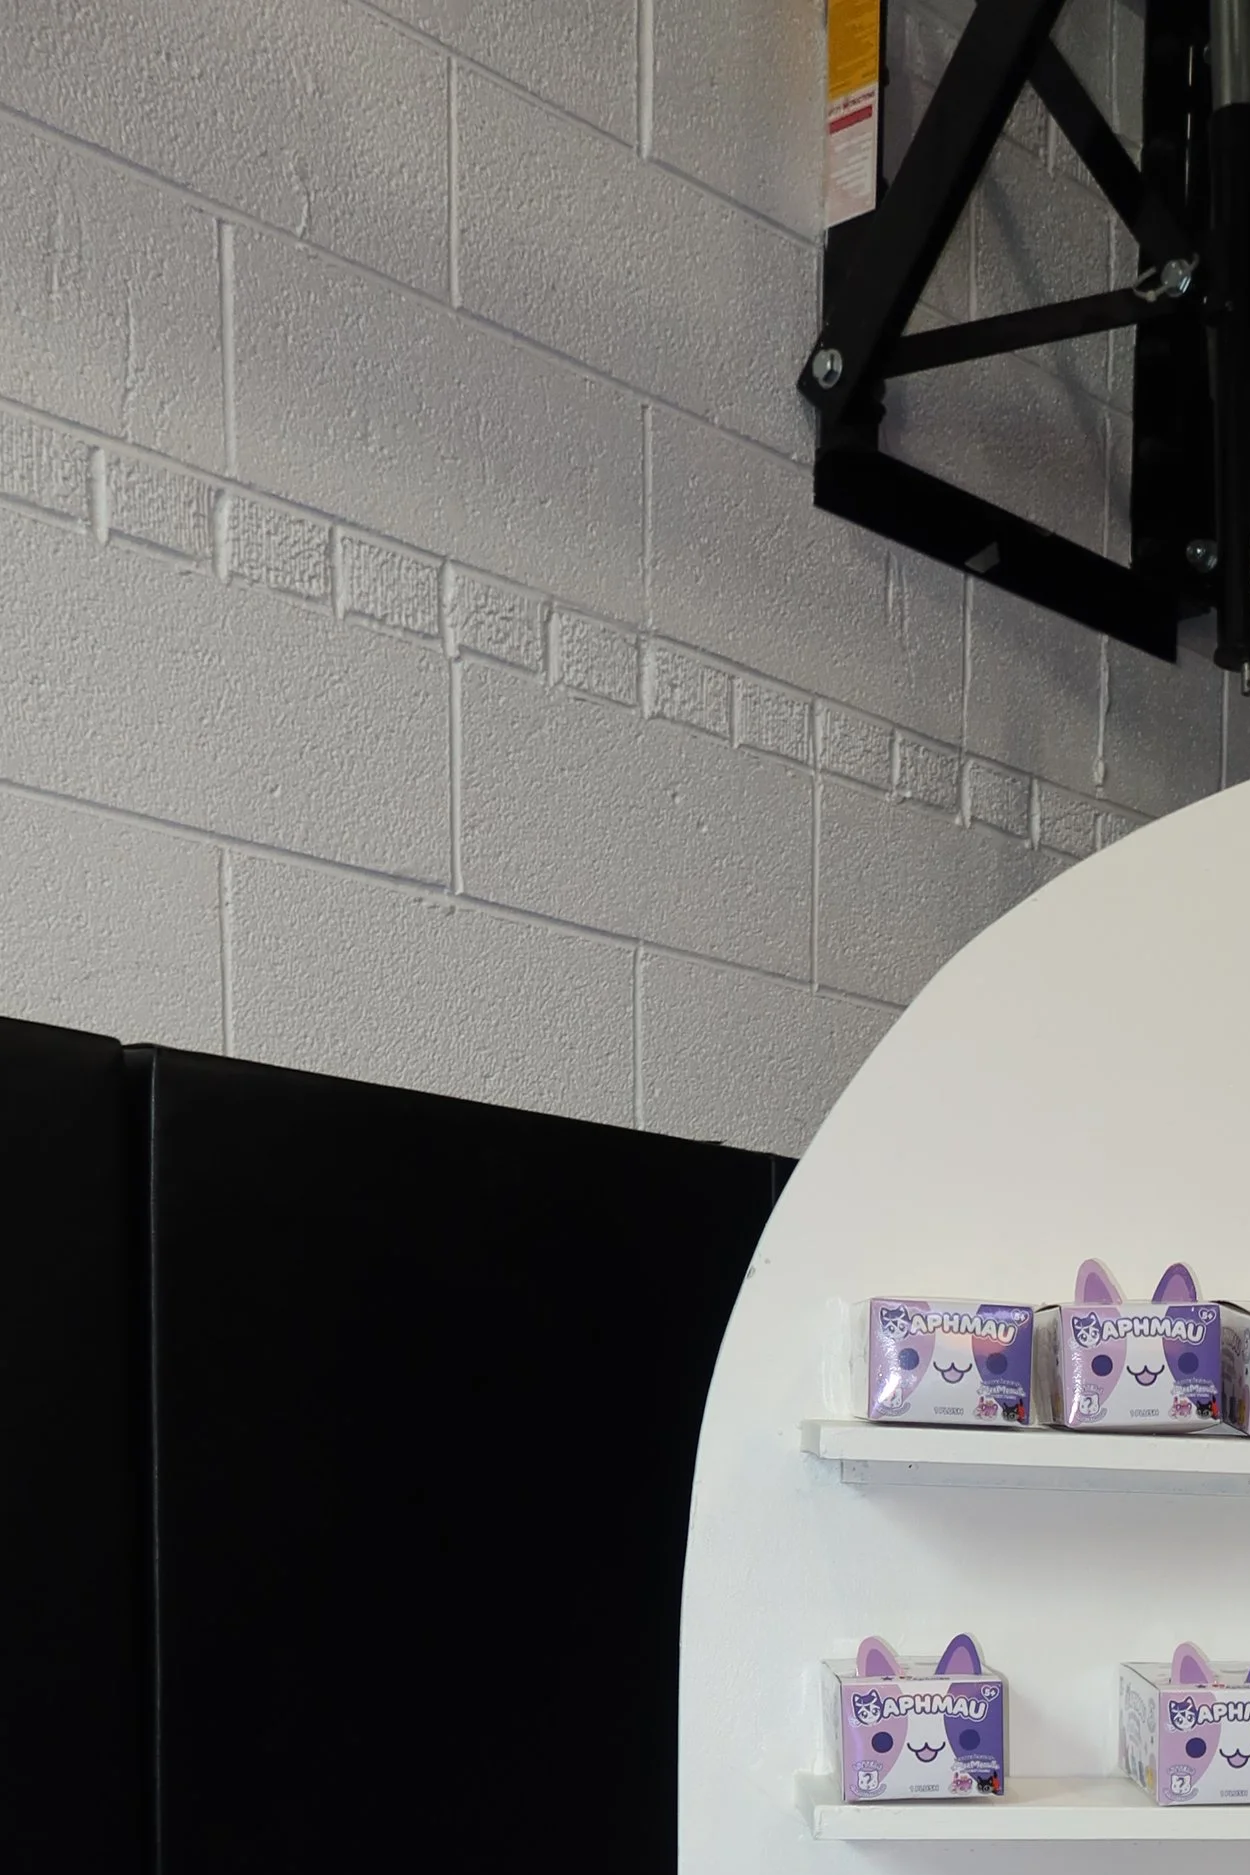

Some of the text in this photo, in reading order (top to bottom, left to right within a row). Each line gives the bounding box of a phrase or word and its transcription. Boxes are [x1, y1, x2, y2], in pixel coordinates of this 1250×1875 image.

[911, 1315, 1015, 1344] APHMAU
[1102, 1317, 1204, 1345] APHMAU
[883, 1694, 987, 1720] APHMAU
